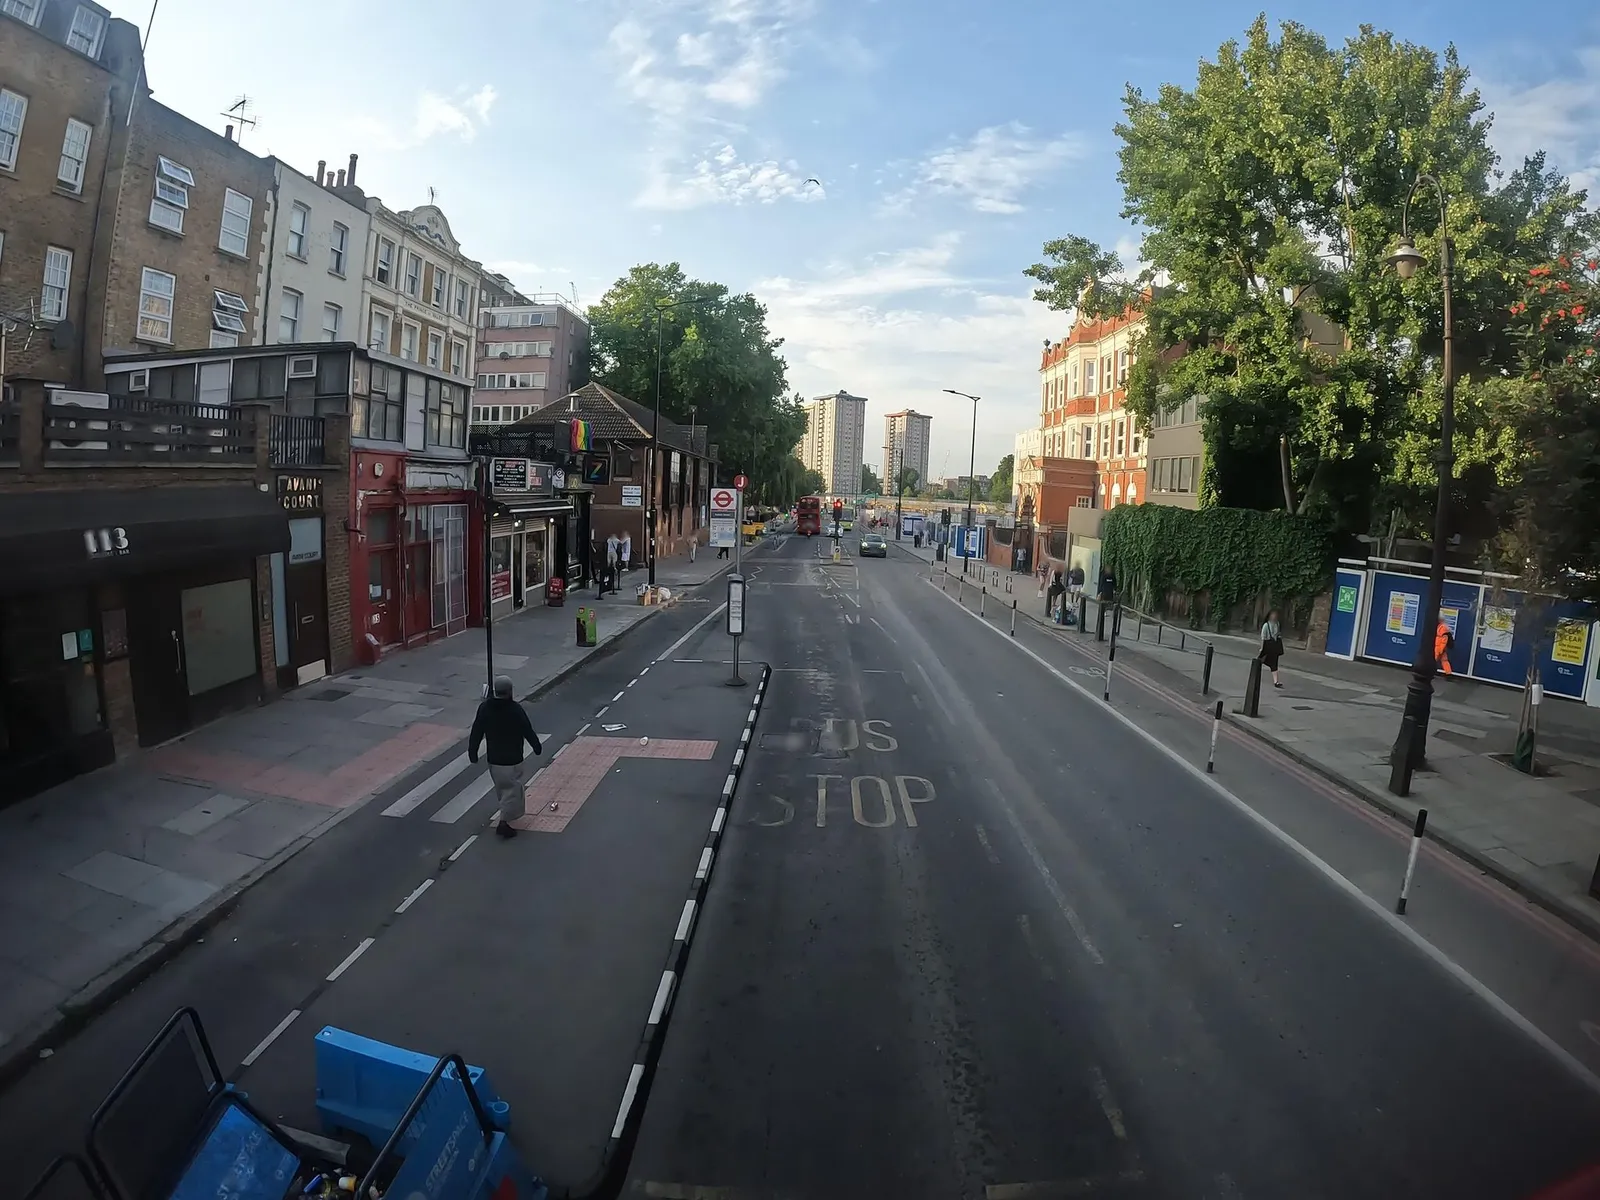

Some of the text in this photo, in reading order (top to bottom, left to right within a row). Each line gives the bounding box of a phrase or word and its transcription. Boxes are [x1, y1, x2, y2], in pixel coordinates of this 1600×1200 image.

[590, 460, 603, 479] Z
[737, 476, 744, 488] J
[283, 494, 320, 510] COURT
[83, 526, 130, 553] 113
